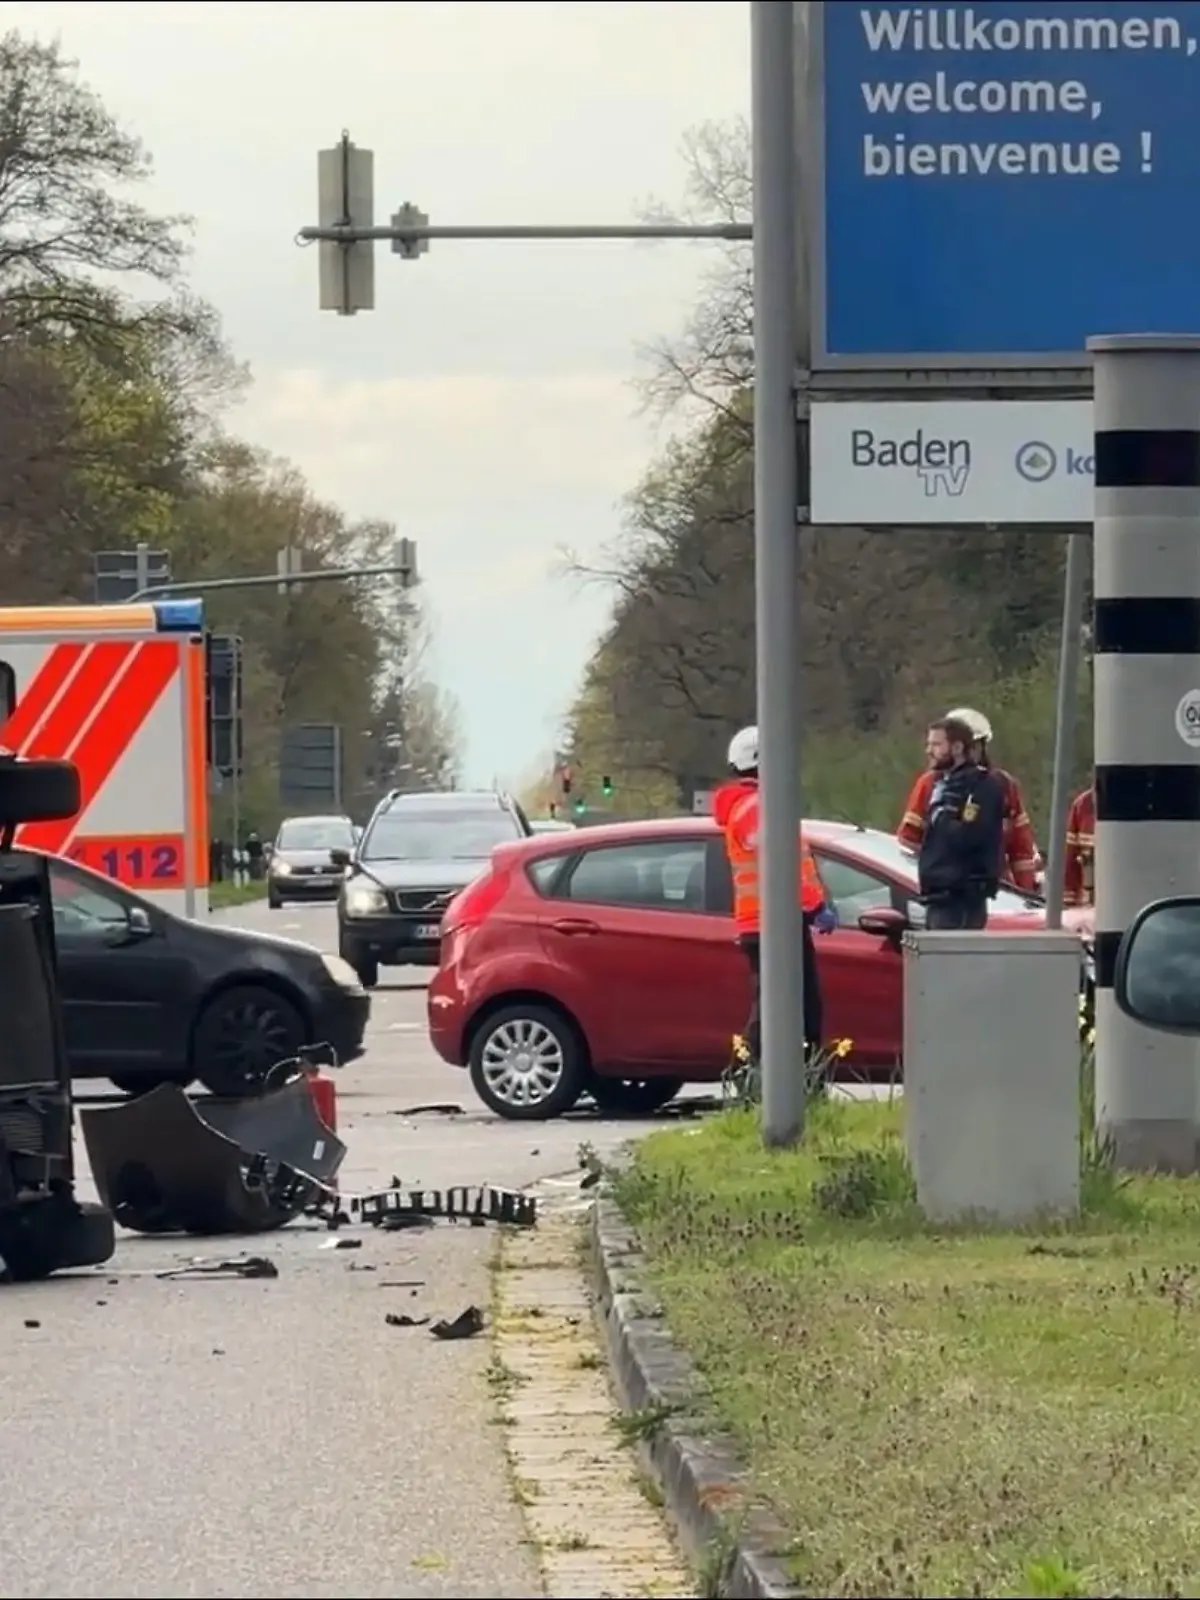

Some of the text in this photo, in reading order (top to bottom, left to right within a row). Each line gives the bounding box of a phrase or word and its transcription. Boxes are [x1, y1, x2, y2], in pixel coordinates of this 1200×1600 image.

[860, 9, 1197, 56] Willkommen,
[861, 71, 1102, 120] welcome,
[863, 134, 1120, 175] bienvenue
[851, 429, 970, 467] Baden
[917, 465, 970, 497] TV
[102, 846, 178, 878] 112
